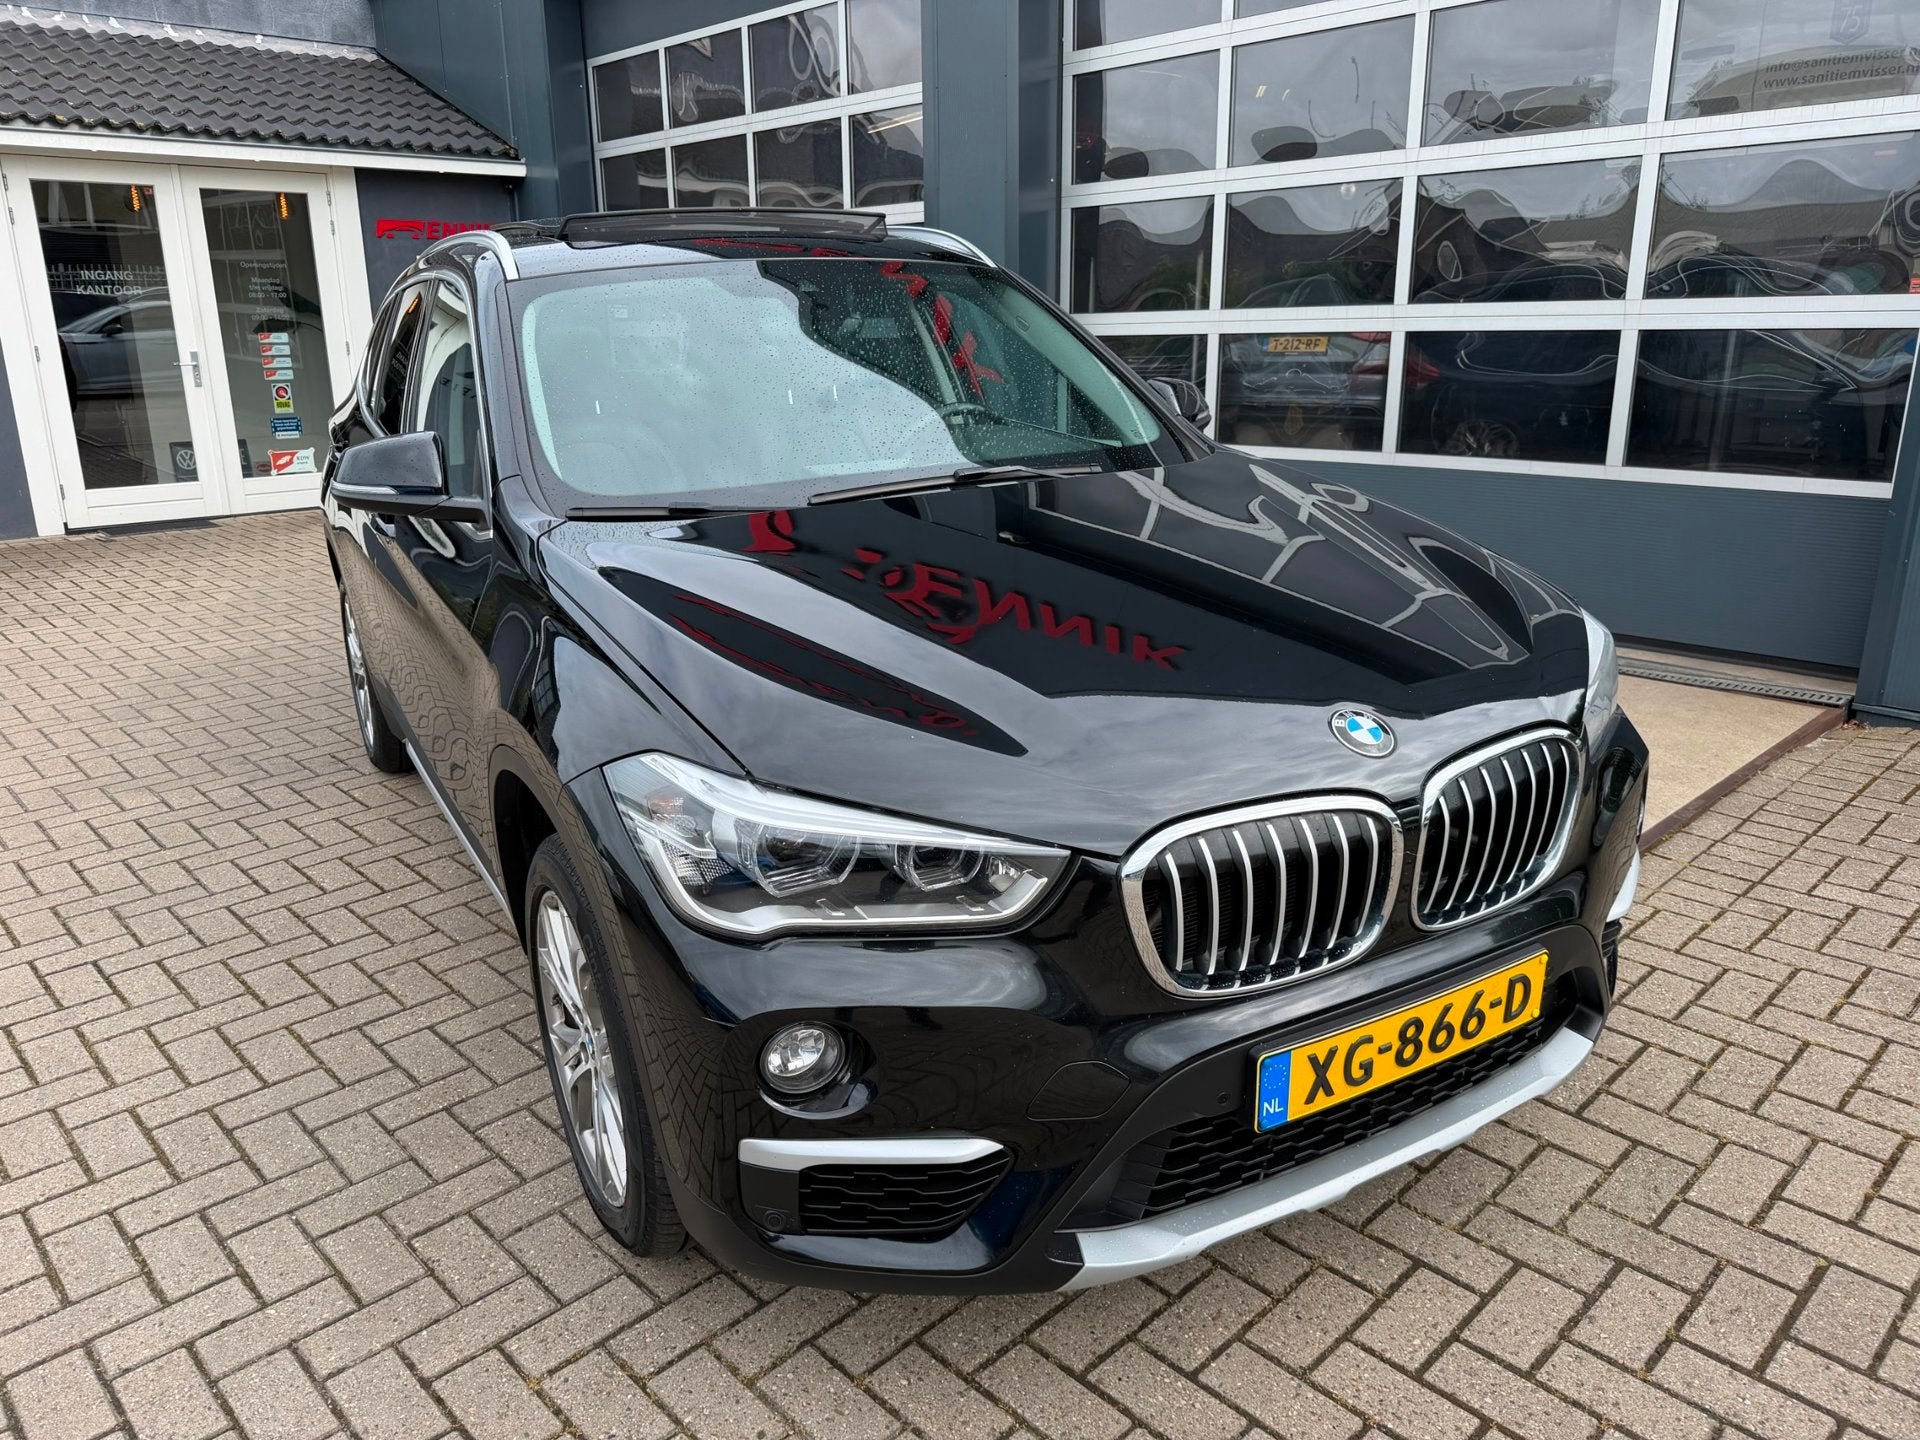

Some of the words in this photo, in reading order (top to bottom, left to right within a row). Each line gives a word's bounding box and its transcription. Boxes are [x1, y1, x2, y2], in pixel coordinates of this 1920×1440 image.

[81, 270, 134, 281] INGANG
[76, 284, 143, 296] KANTOOR
[1273, 338, 1322, 350] T-212-RF
[1334, 710, 1373, 727] BMW
[1304, 973, 1532, 1105] XG-866-D
[1262, 1097, 1284, 1116] NL
